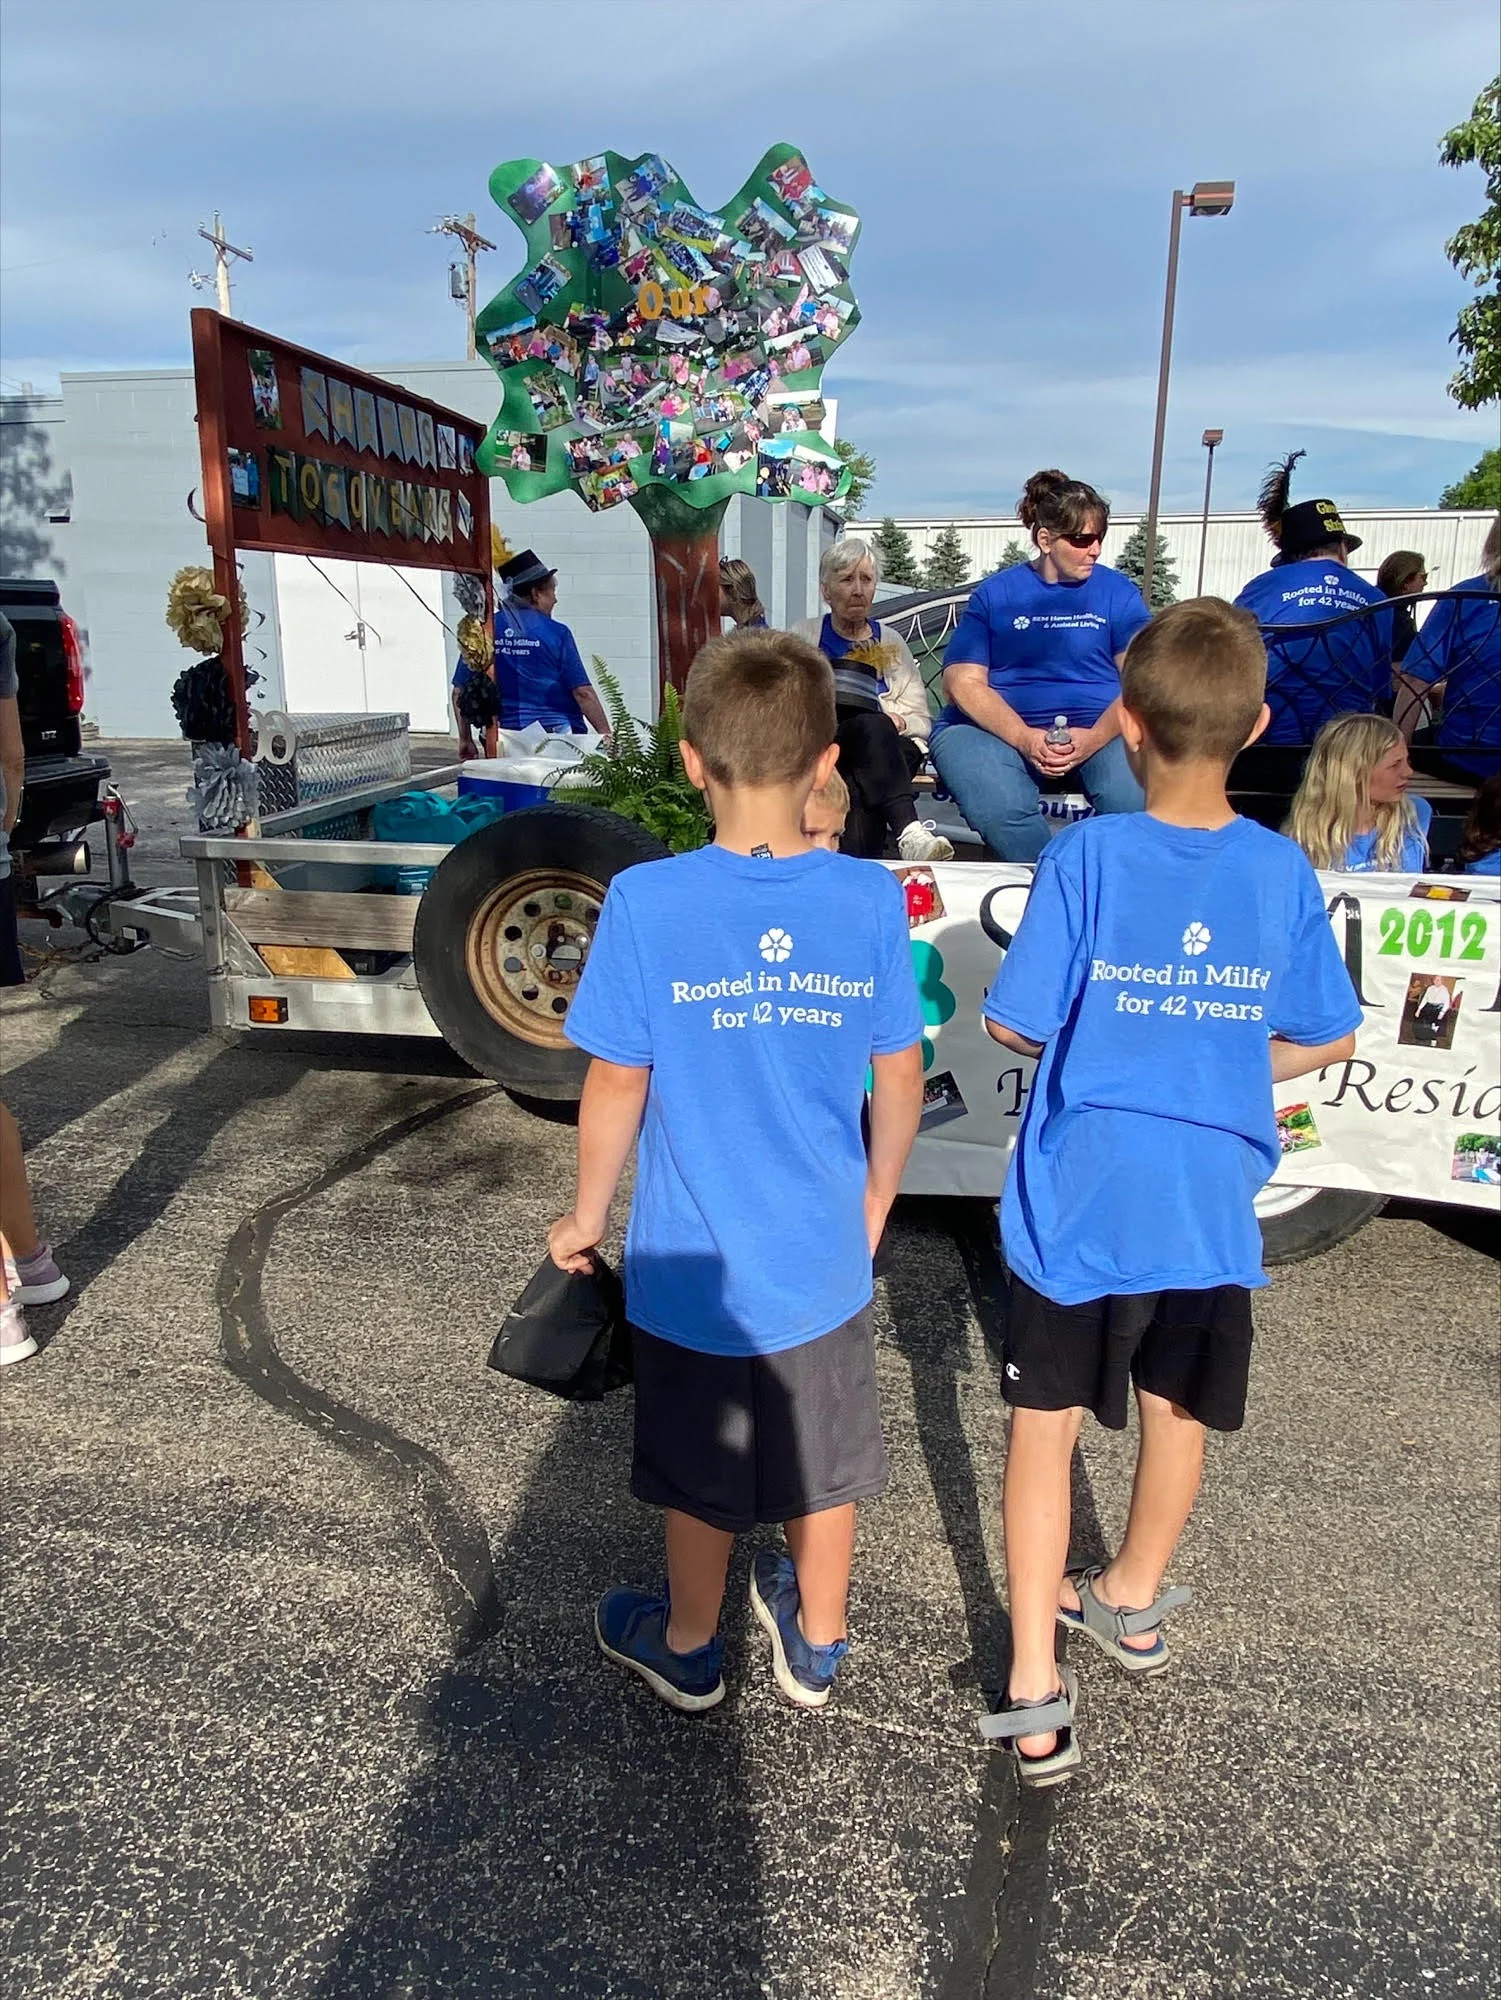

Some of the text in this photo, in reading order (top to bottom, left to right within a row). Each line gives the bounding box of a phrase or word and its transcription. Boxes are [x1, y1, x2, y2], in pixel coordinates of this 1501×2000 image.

[639, 281, 711, 320] Our
[327, 472, 362, 519] 60
[366, 477, 449, 531] YEARS
[1282, 585, 1323, 602] Rooted
[1324, 585, 1336, 595] in
[1298, 597, 1317, 607] for
[1318, 596, 1333, 606] 42
[1377, 907, 1488, 961] 2012
[671, 971, 874, 1004] Rooted in Milford
[1090, 959, 1173, 986] Rooted
[1176, 964, 1199, 986] in
[712, 1001, 843, 1030] for 42 years
[1115, 991, 1264, 1022] for 42 years
